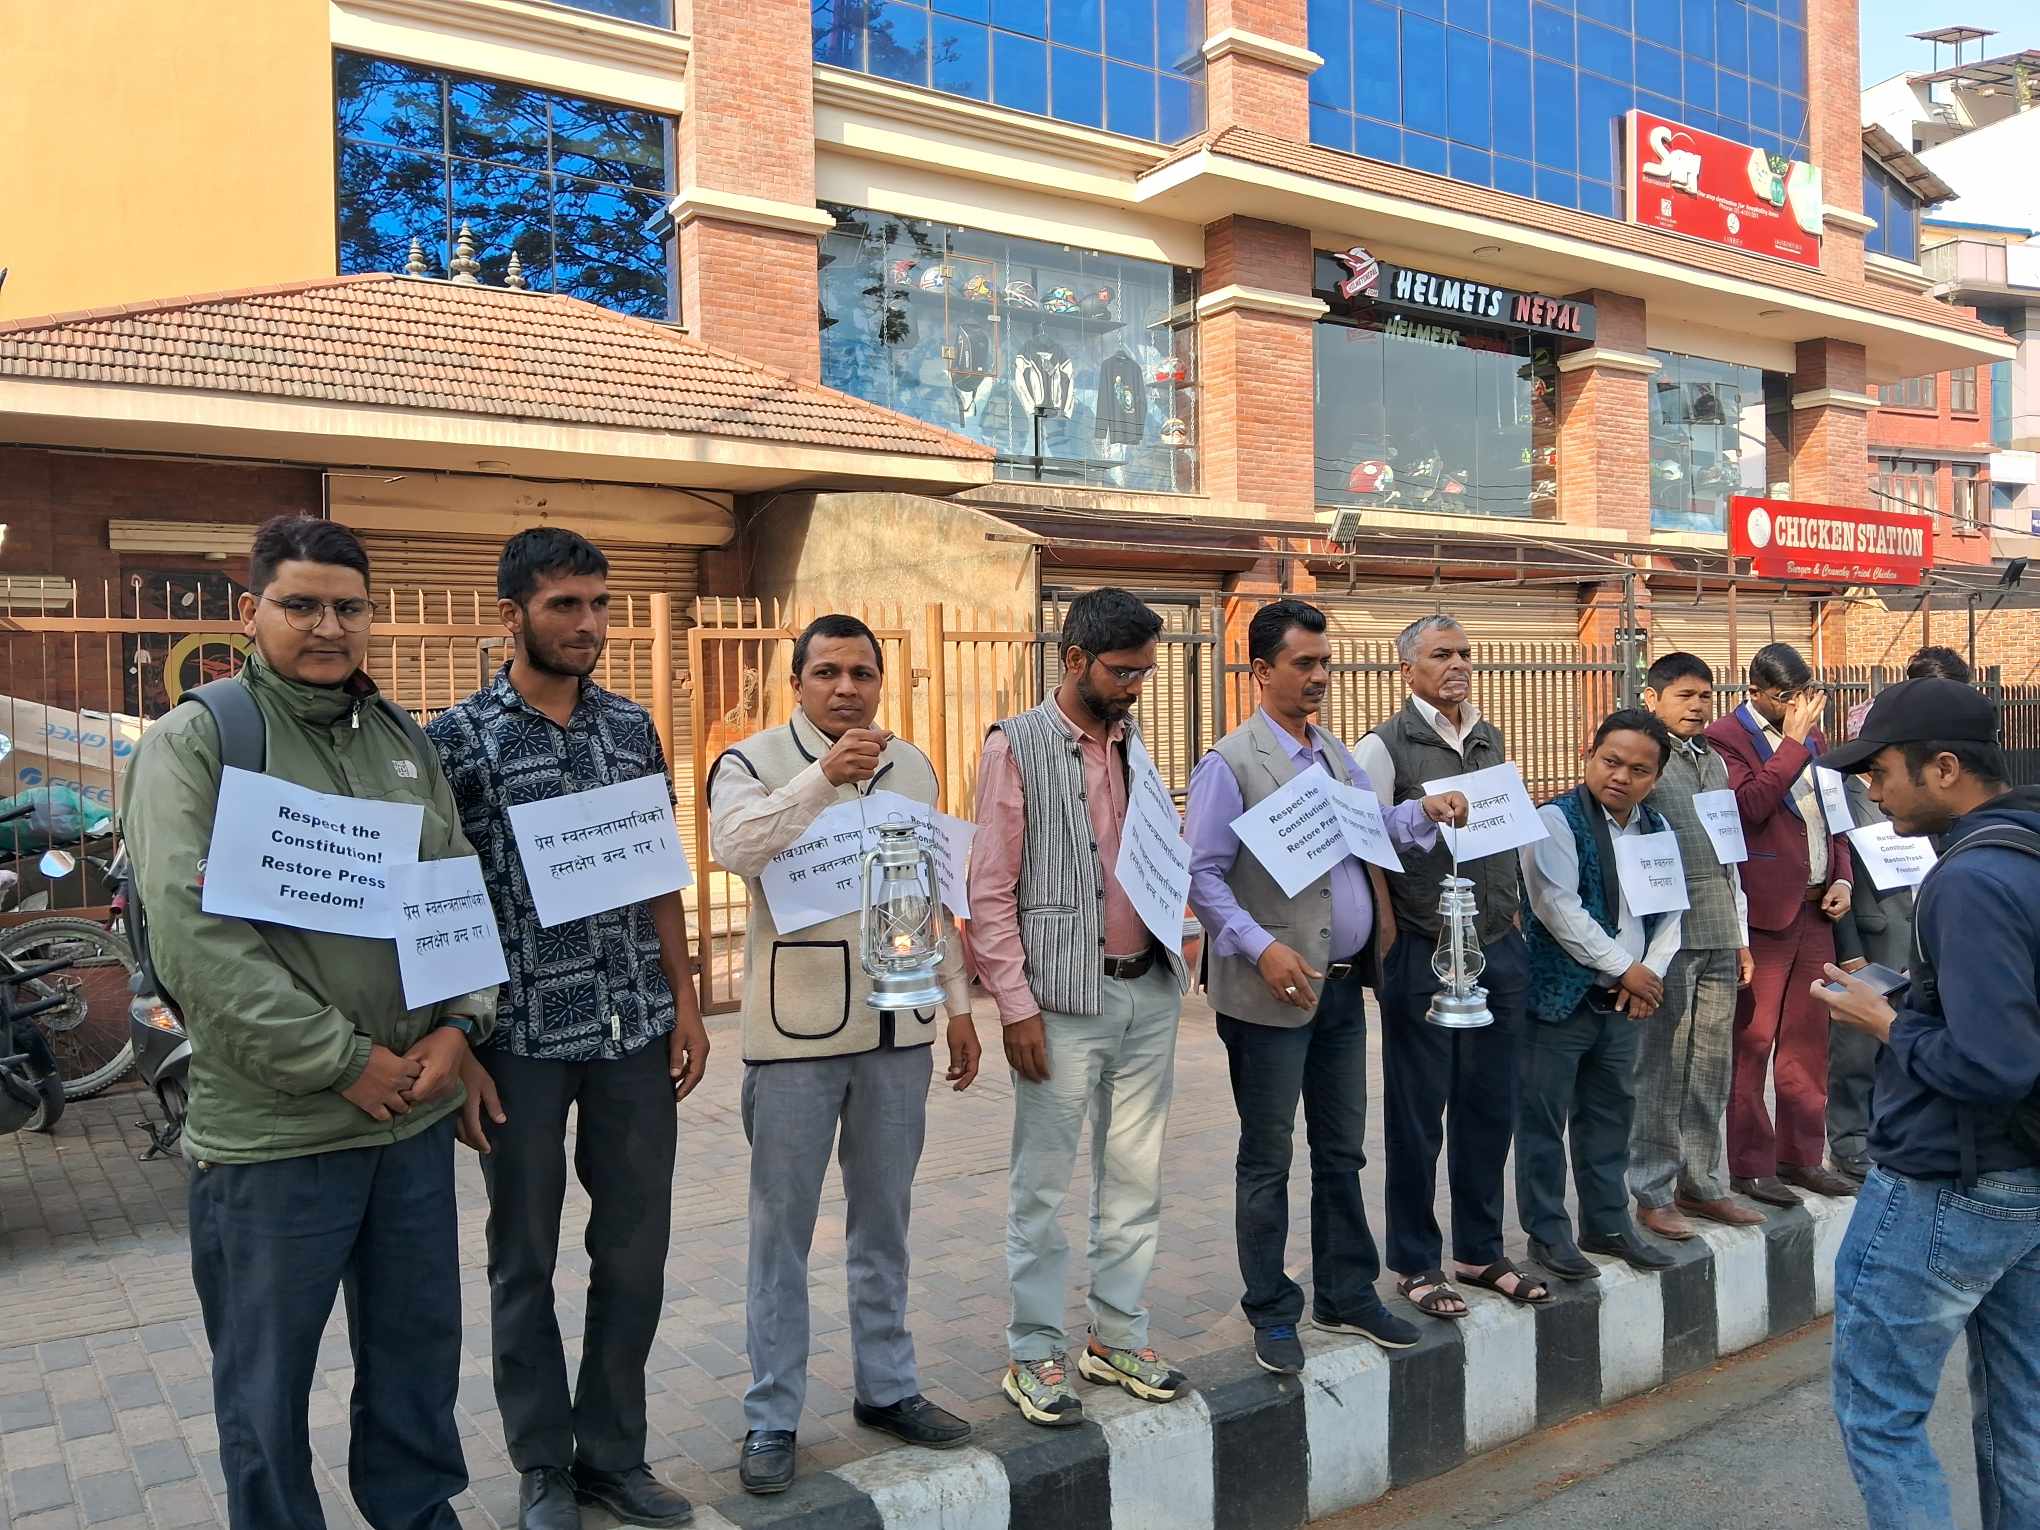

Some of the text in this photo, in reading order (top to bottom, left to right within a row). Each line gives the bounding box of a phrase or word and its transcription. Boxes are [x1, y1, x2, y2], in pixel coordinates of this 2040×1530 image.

[1397, 270, 1582, 333] HELMETS NEPAL
[1775, 515, 1924, 557] CHICKEN STATION
[1269, 787, 1320, 824] Respect the
[1278, 798, 1330, 838] Constitution!
[278, 806, 381, 840] Respect the
[1286, 826, 1321, 853] Restore
[1320, 815, 1338, 830] Pres
[271, 830, 383, 864] Constitution!
[534, 834, 555, 851] प्रेस
[632, 840, 654, 855] गर
[1306, 831, 1344, 860] Freedom!
[261, 855, 386, 889] Restore Press
[279, 884, 365, 909] Freedom!
